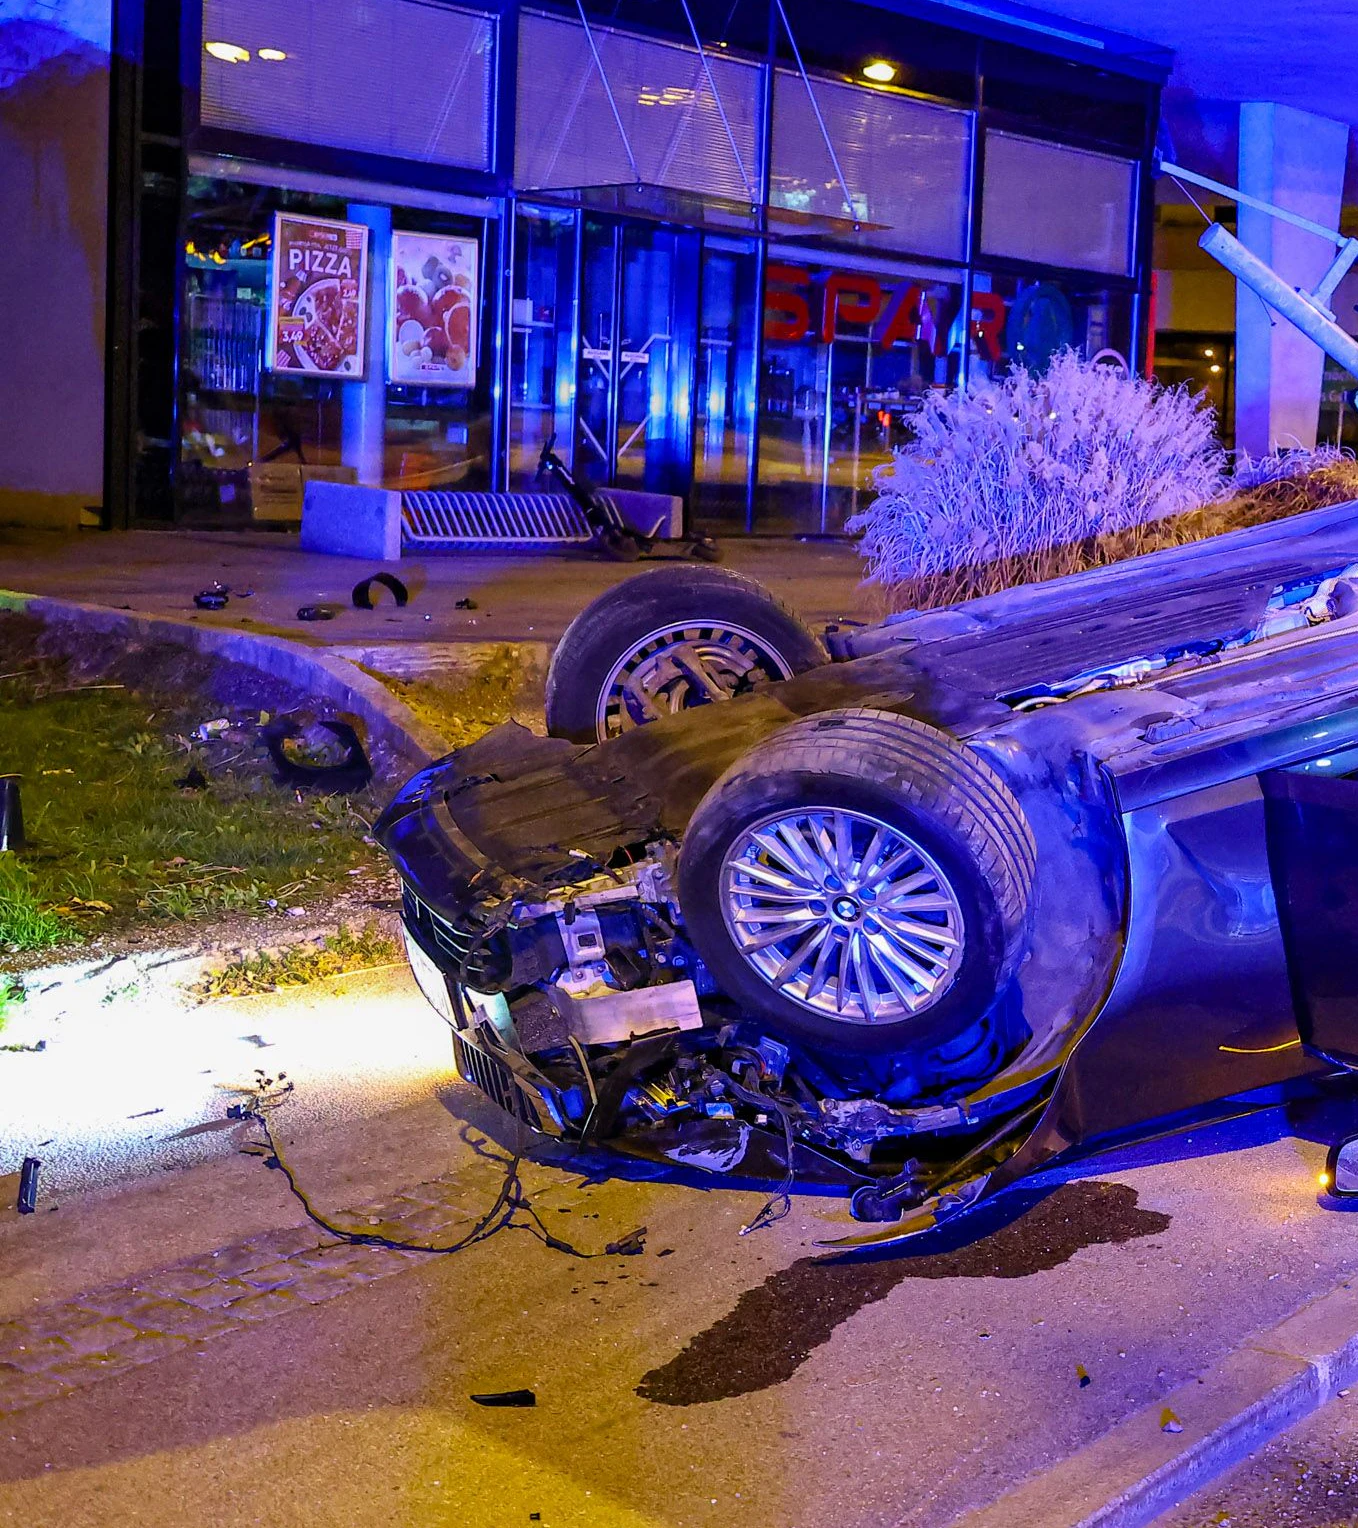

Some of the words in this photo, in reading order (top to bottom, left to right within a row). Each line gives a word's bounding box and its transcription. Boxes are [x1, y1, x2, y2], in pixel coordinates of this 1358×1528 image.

[289, 249, 352, 279] PIZZA
[765, 264, 1006, 361] SPAR
[282, 330, 304, 343] 3,49
